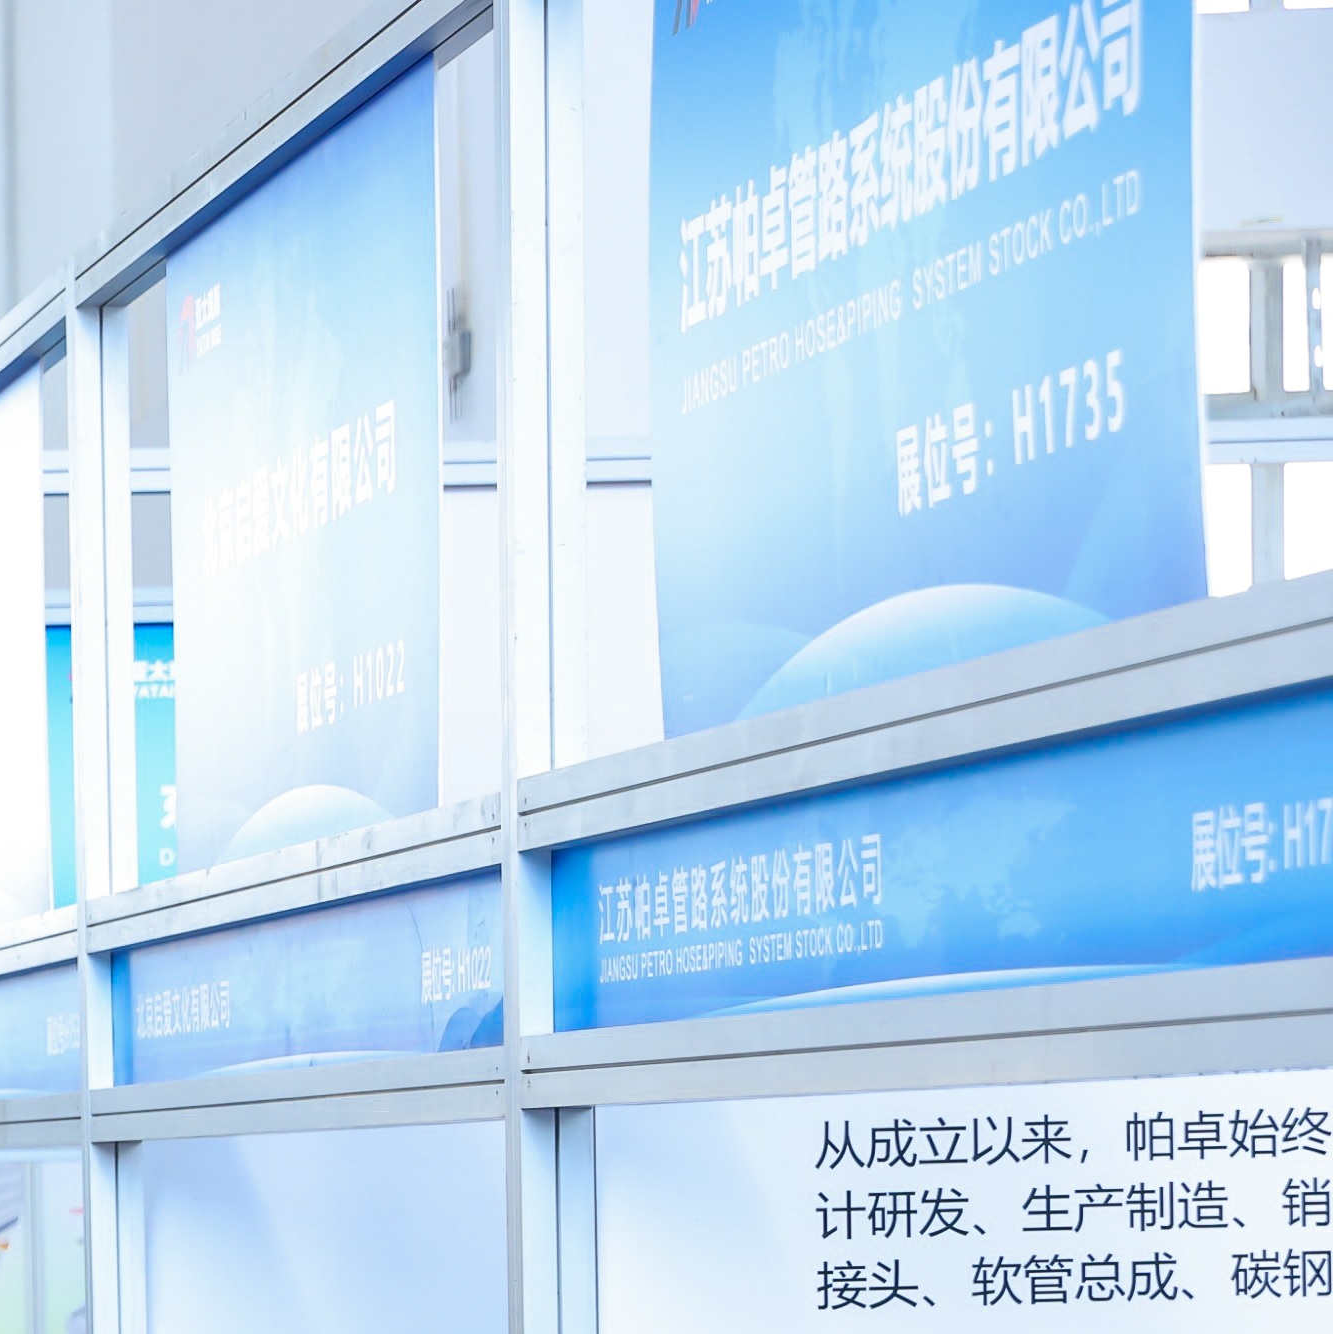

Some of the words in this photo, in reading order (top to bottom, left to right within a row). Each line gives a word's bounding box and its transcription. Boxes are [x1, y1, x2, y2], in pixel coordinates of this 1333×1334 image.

[680, 0, 1141, 334] 江苏帕卓管路系统股份有限公司
[680, 355, 736, 414] JIANGSU
[742, 331, 790, 387] PETRO
[794, 279, 901, 364] HOSE&PIPING
[912, 241, 982, 310] SYSTEM
[989, 208, 1052, 276] STOCK
[1059, 169, 1140, 244] CO.,LTD
[598, 833, 881, 945] 江苏帕卓管路系统股份有限公司
[600, 954, 637, 983] JIANGSU
[641, 949, 672, 978] PETRO
[676, 939, 742, 974] HOSE&PIPING
[749, 932, 791, 964] SYSTEM
[795, 926, 831, 958] STOCK
[836, 920, 882, 955] CO.,LTD
[815, 1107, 1332, 1170] 从成立以来，帕卓始终
[815, 1177, 1331, 1240] 计研发、生产制造、销
[817, 1248, 1333, 1310] 接头、软管总成、碳钢
